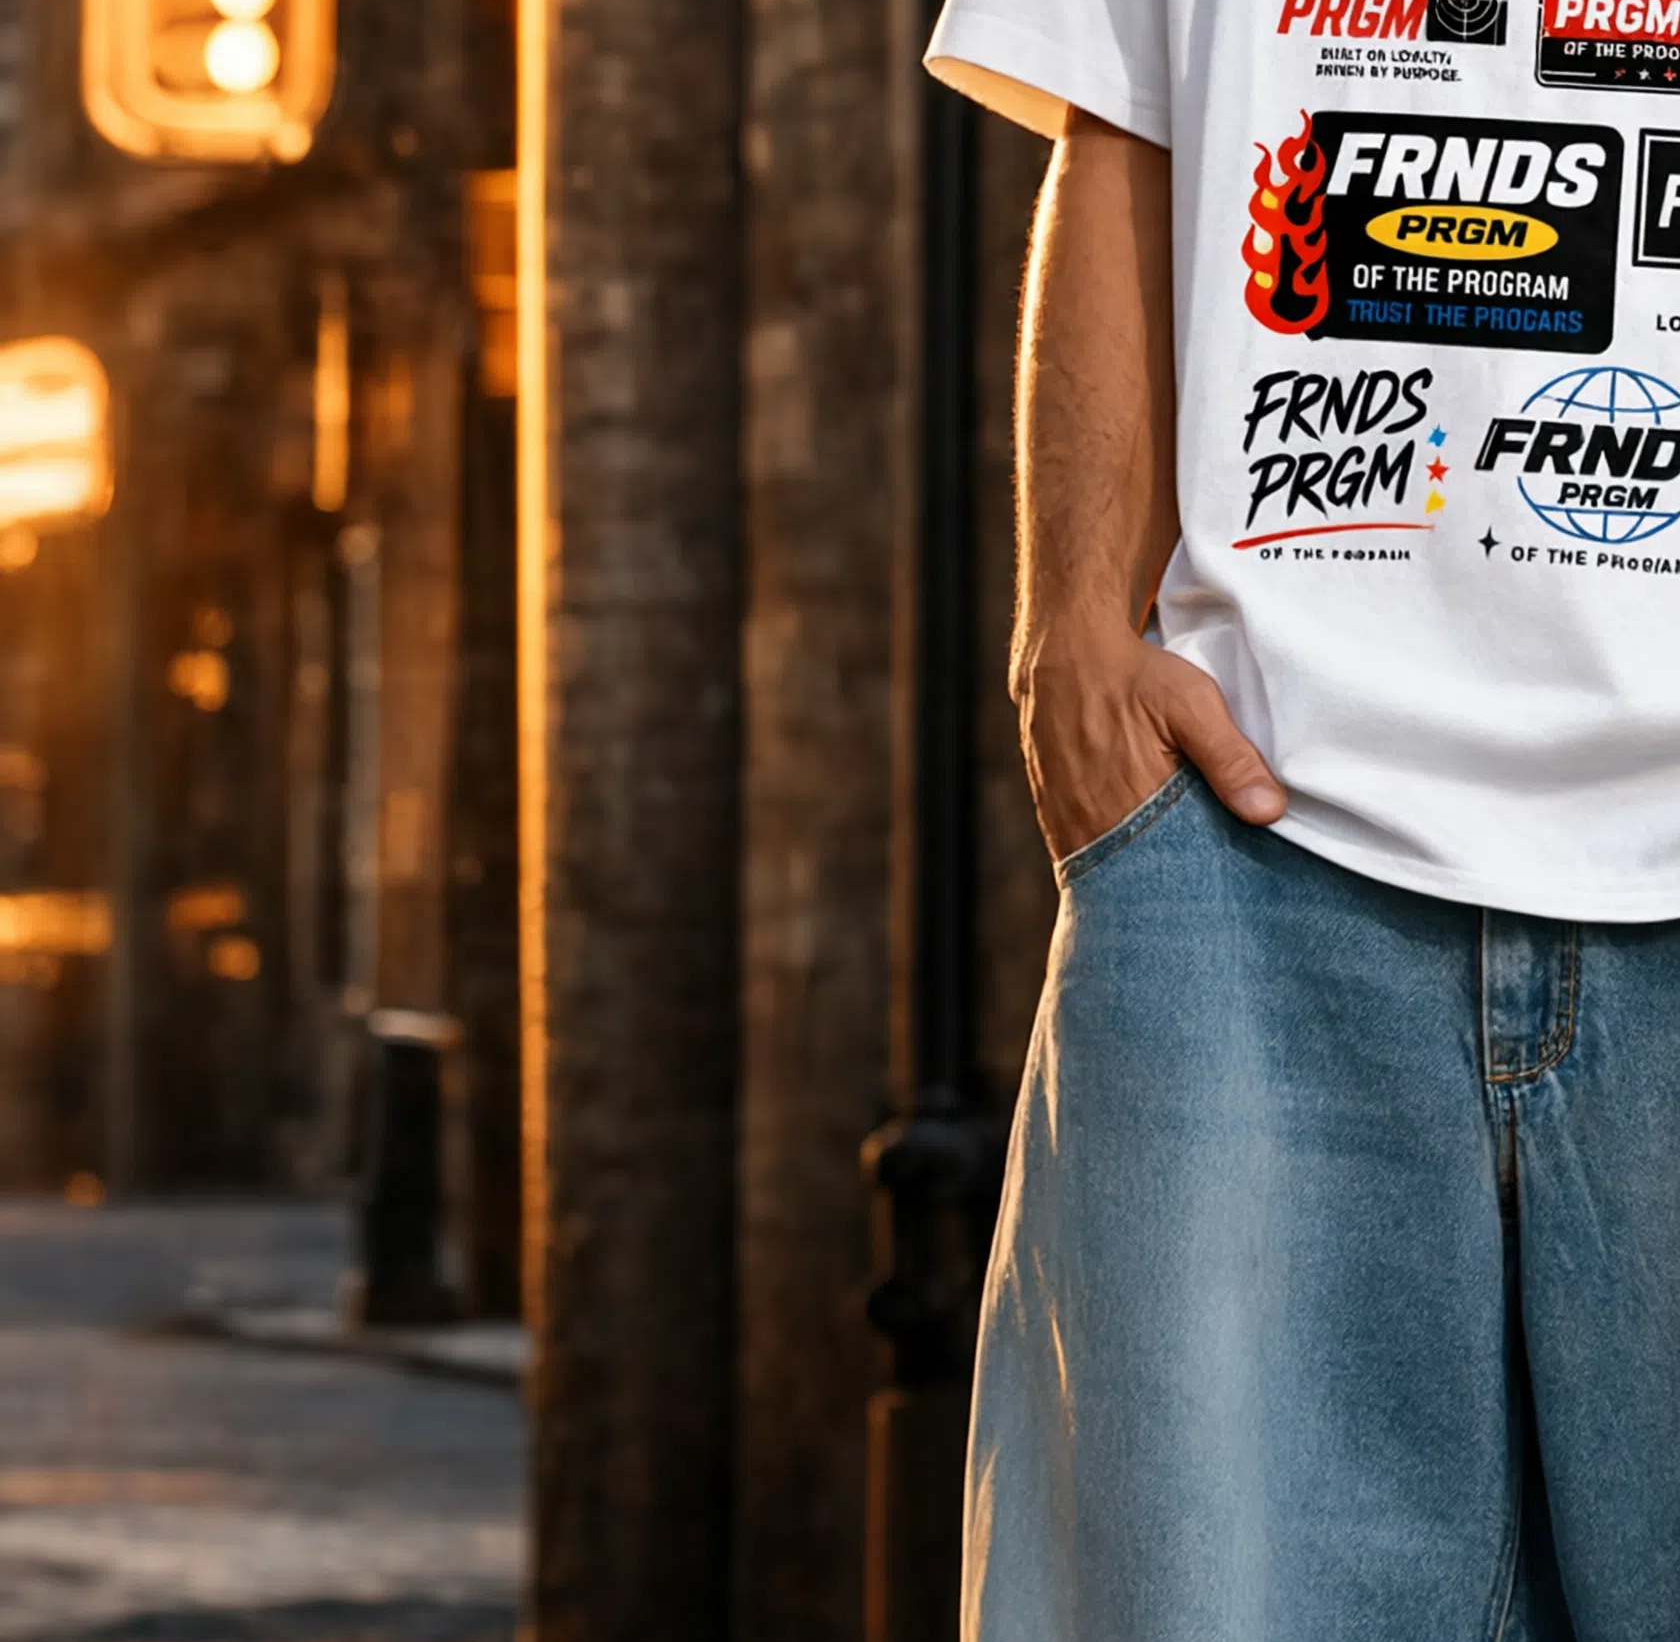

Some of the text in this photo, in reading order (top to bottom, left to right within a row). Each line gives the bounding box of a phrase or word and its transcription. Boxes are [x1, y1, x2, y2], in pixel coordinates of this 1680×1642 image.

[1595, 43, 1626, 58] THE
[1326, 132, 1606, 209] FRNDS
[1396, 215, 1529, 248] PRGM
[1353, 264, 1569, 300] OF THE PROGRAM
[1424, 303, 1468, 328] THE
[1243, 367, 1433, 454] FRNDS
[1245, 439, 1415, 531] PRGM
[1557, 482, 1660, 510] PRGM
[1511, 546, 1538, 562] OF
[1547, 548, 1588, 565] THE
